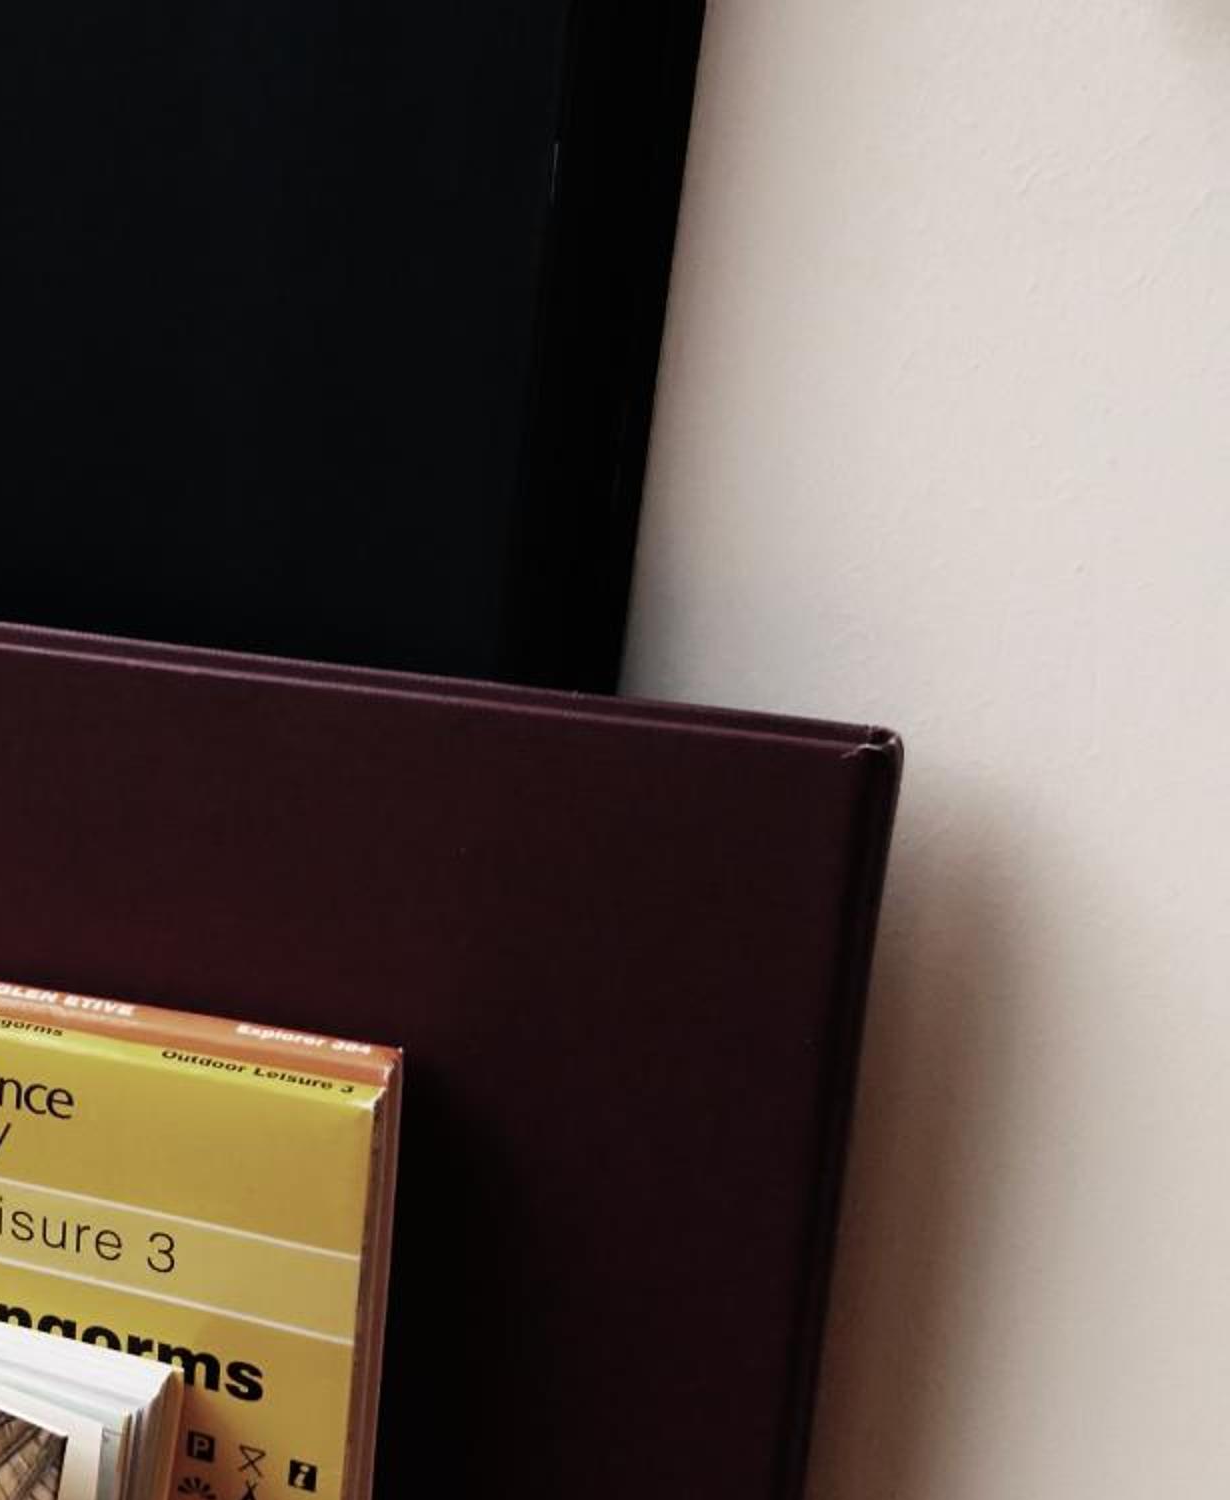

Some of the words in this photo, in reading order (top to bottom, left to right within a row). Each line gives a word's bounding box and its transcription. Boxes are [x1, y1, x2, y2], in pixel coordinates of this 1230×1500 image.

[63, 993, 137, 1017] ETIVE
[235, 1023, 327, 1048] Explorer
[161, 1050, 249, 1074] Outdoor
[253, 1066, 334, 1090] Leisure
[146, 1231, 177, 1274] 3
